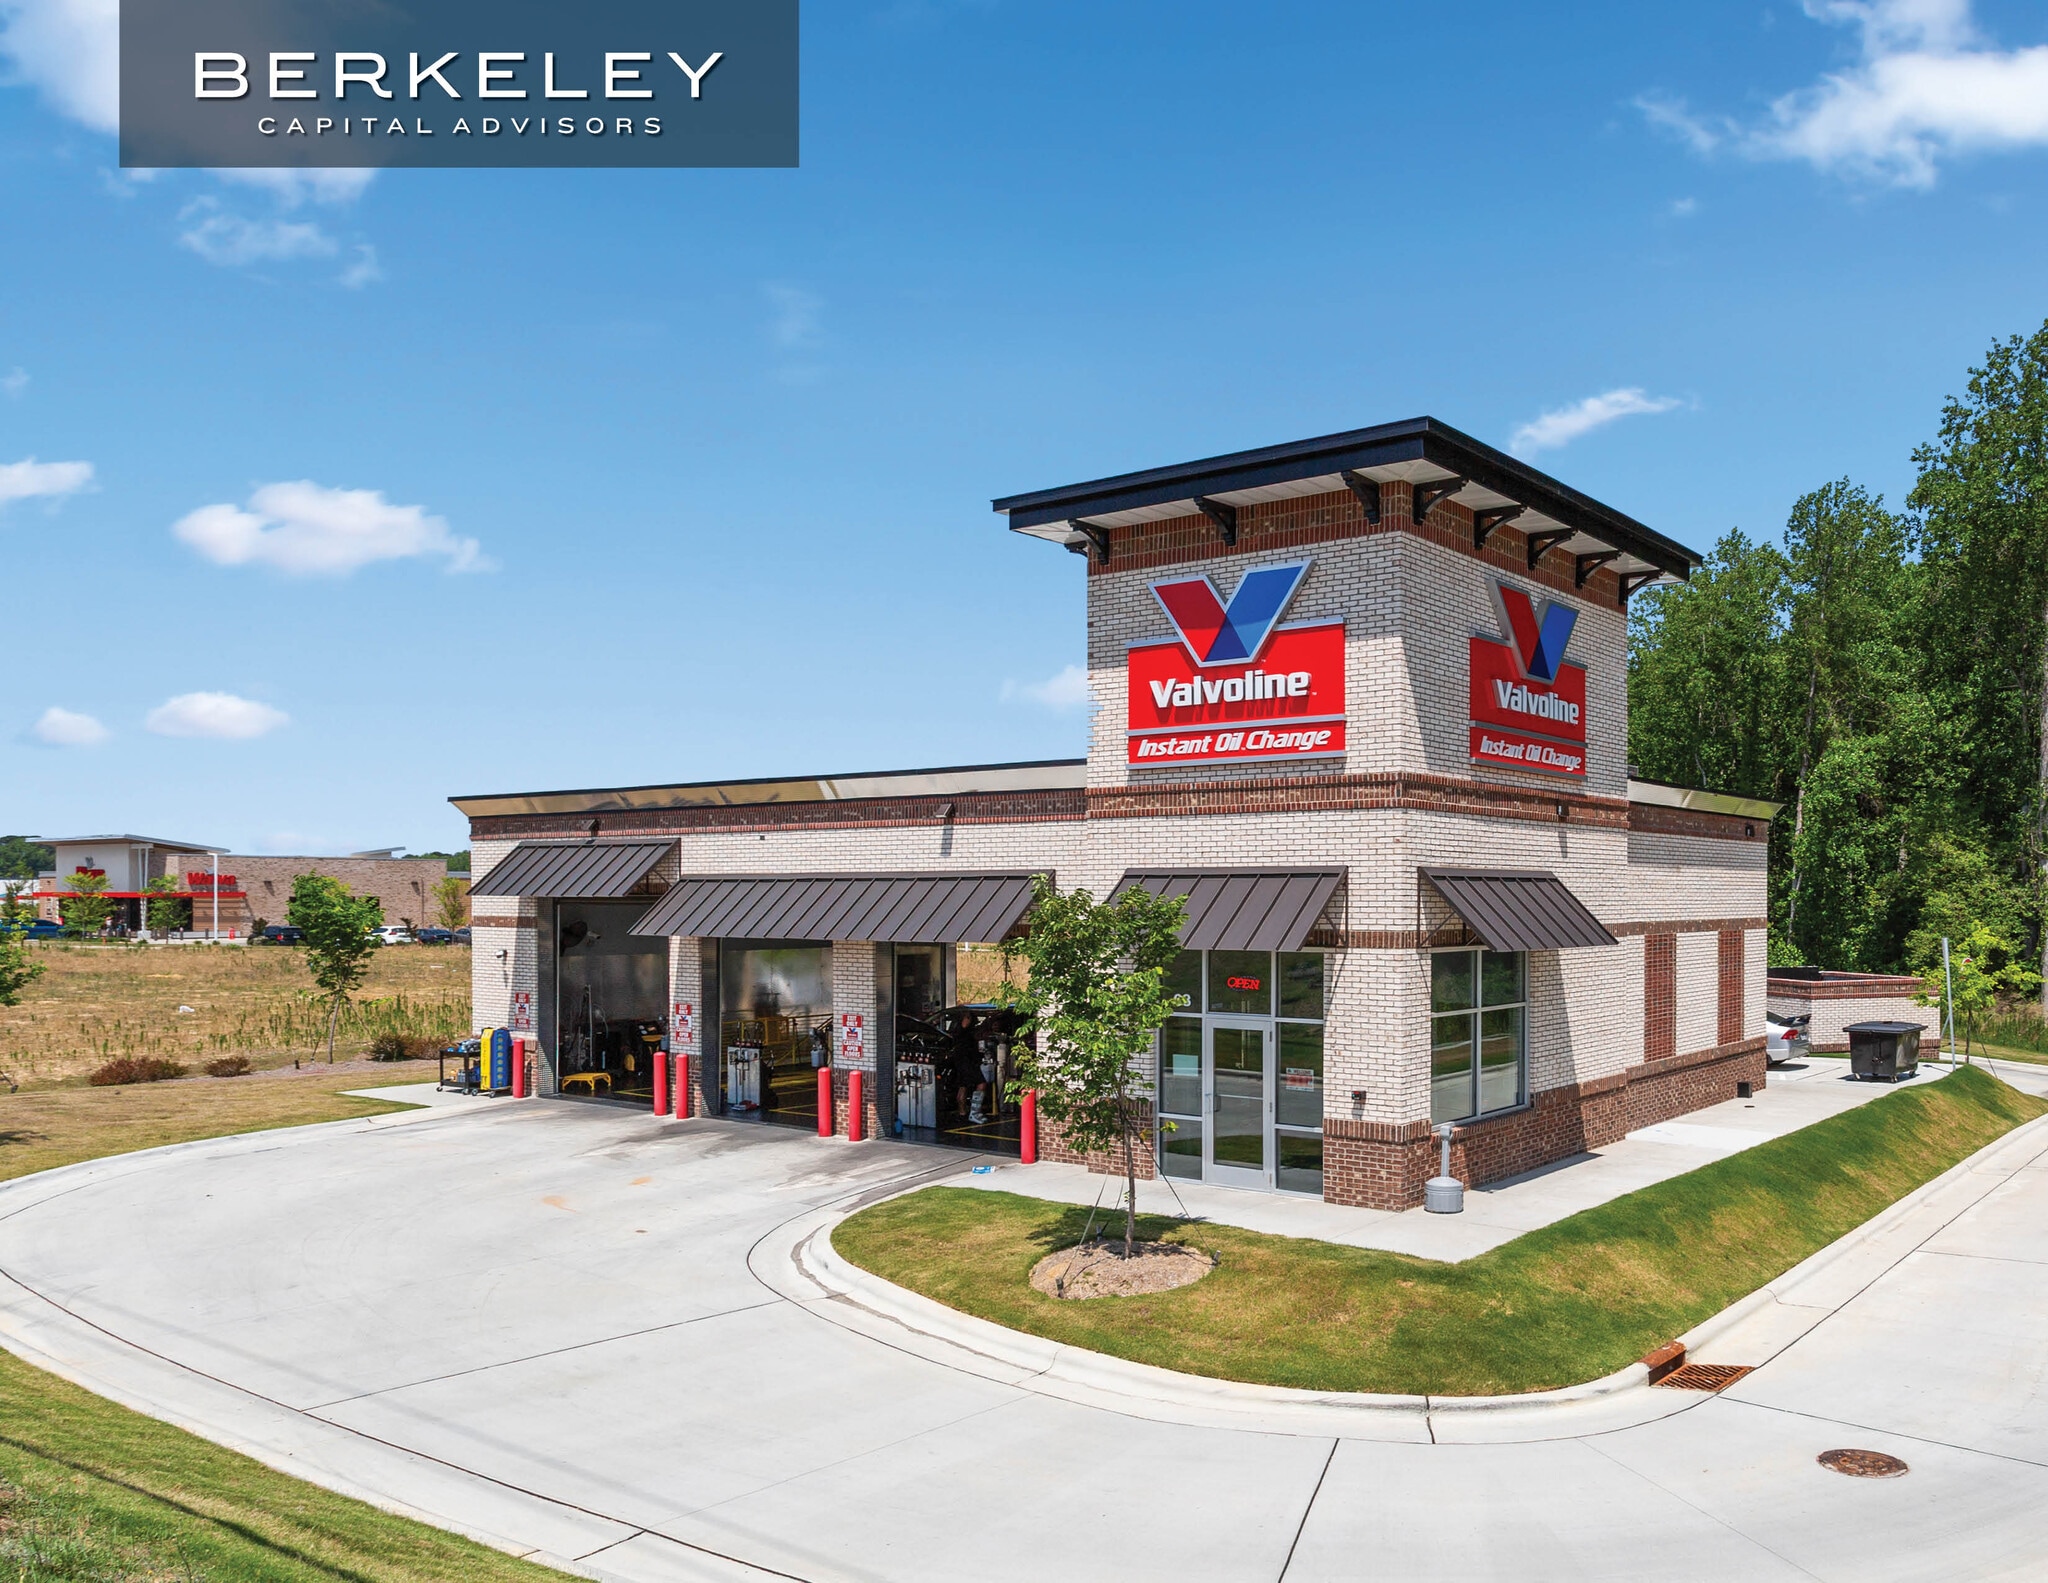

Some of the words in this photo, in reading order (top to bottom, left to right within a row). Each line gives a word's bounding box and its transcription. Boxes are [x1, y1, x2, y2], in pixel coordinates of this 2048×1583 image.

[1149, 669, 1311, 709] Valvoline
[1494, 679, 1580, 725] Valvoline
[1137, 735, 1213, 758] Instant
[1214, 732, 1245, 752] Oil
[1245, 729, 1331, 751] Change
[1480, 735, 1525, 760] Instant
[1525, 744, 1542, 762] Oil
[1542, 747, 1582, 771] Change
[1227, 976, 1260, 990] OPEN
